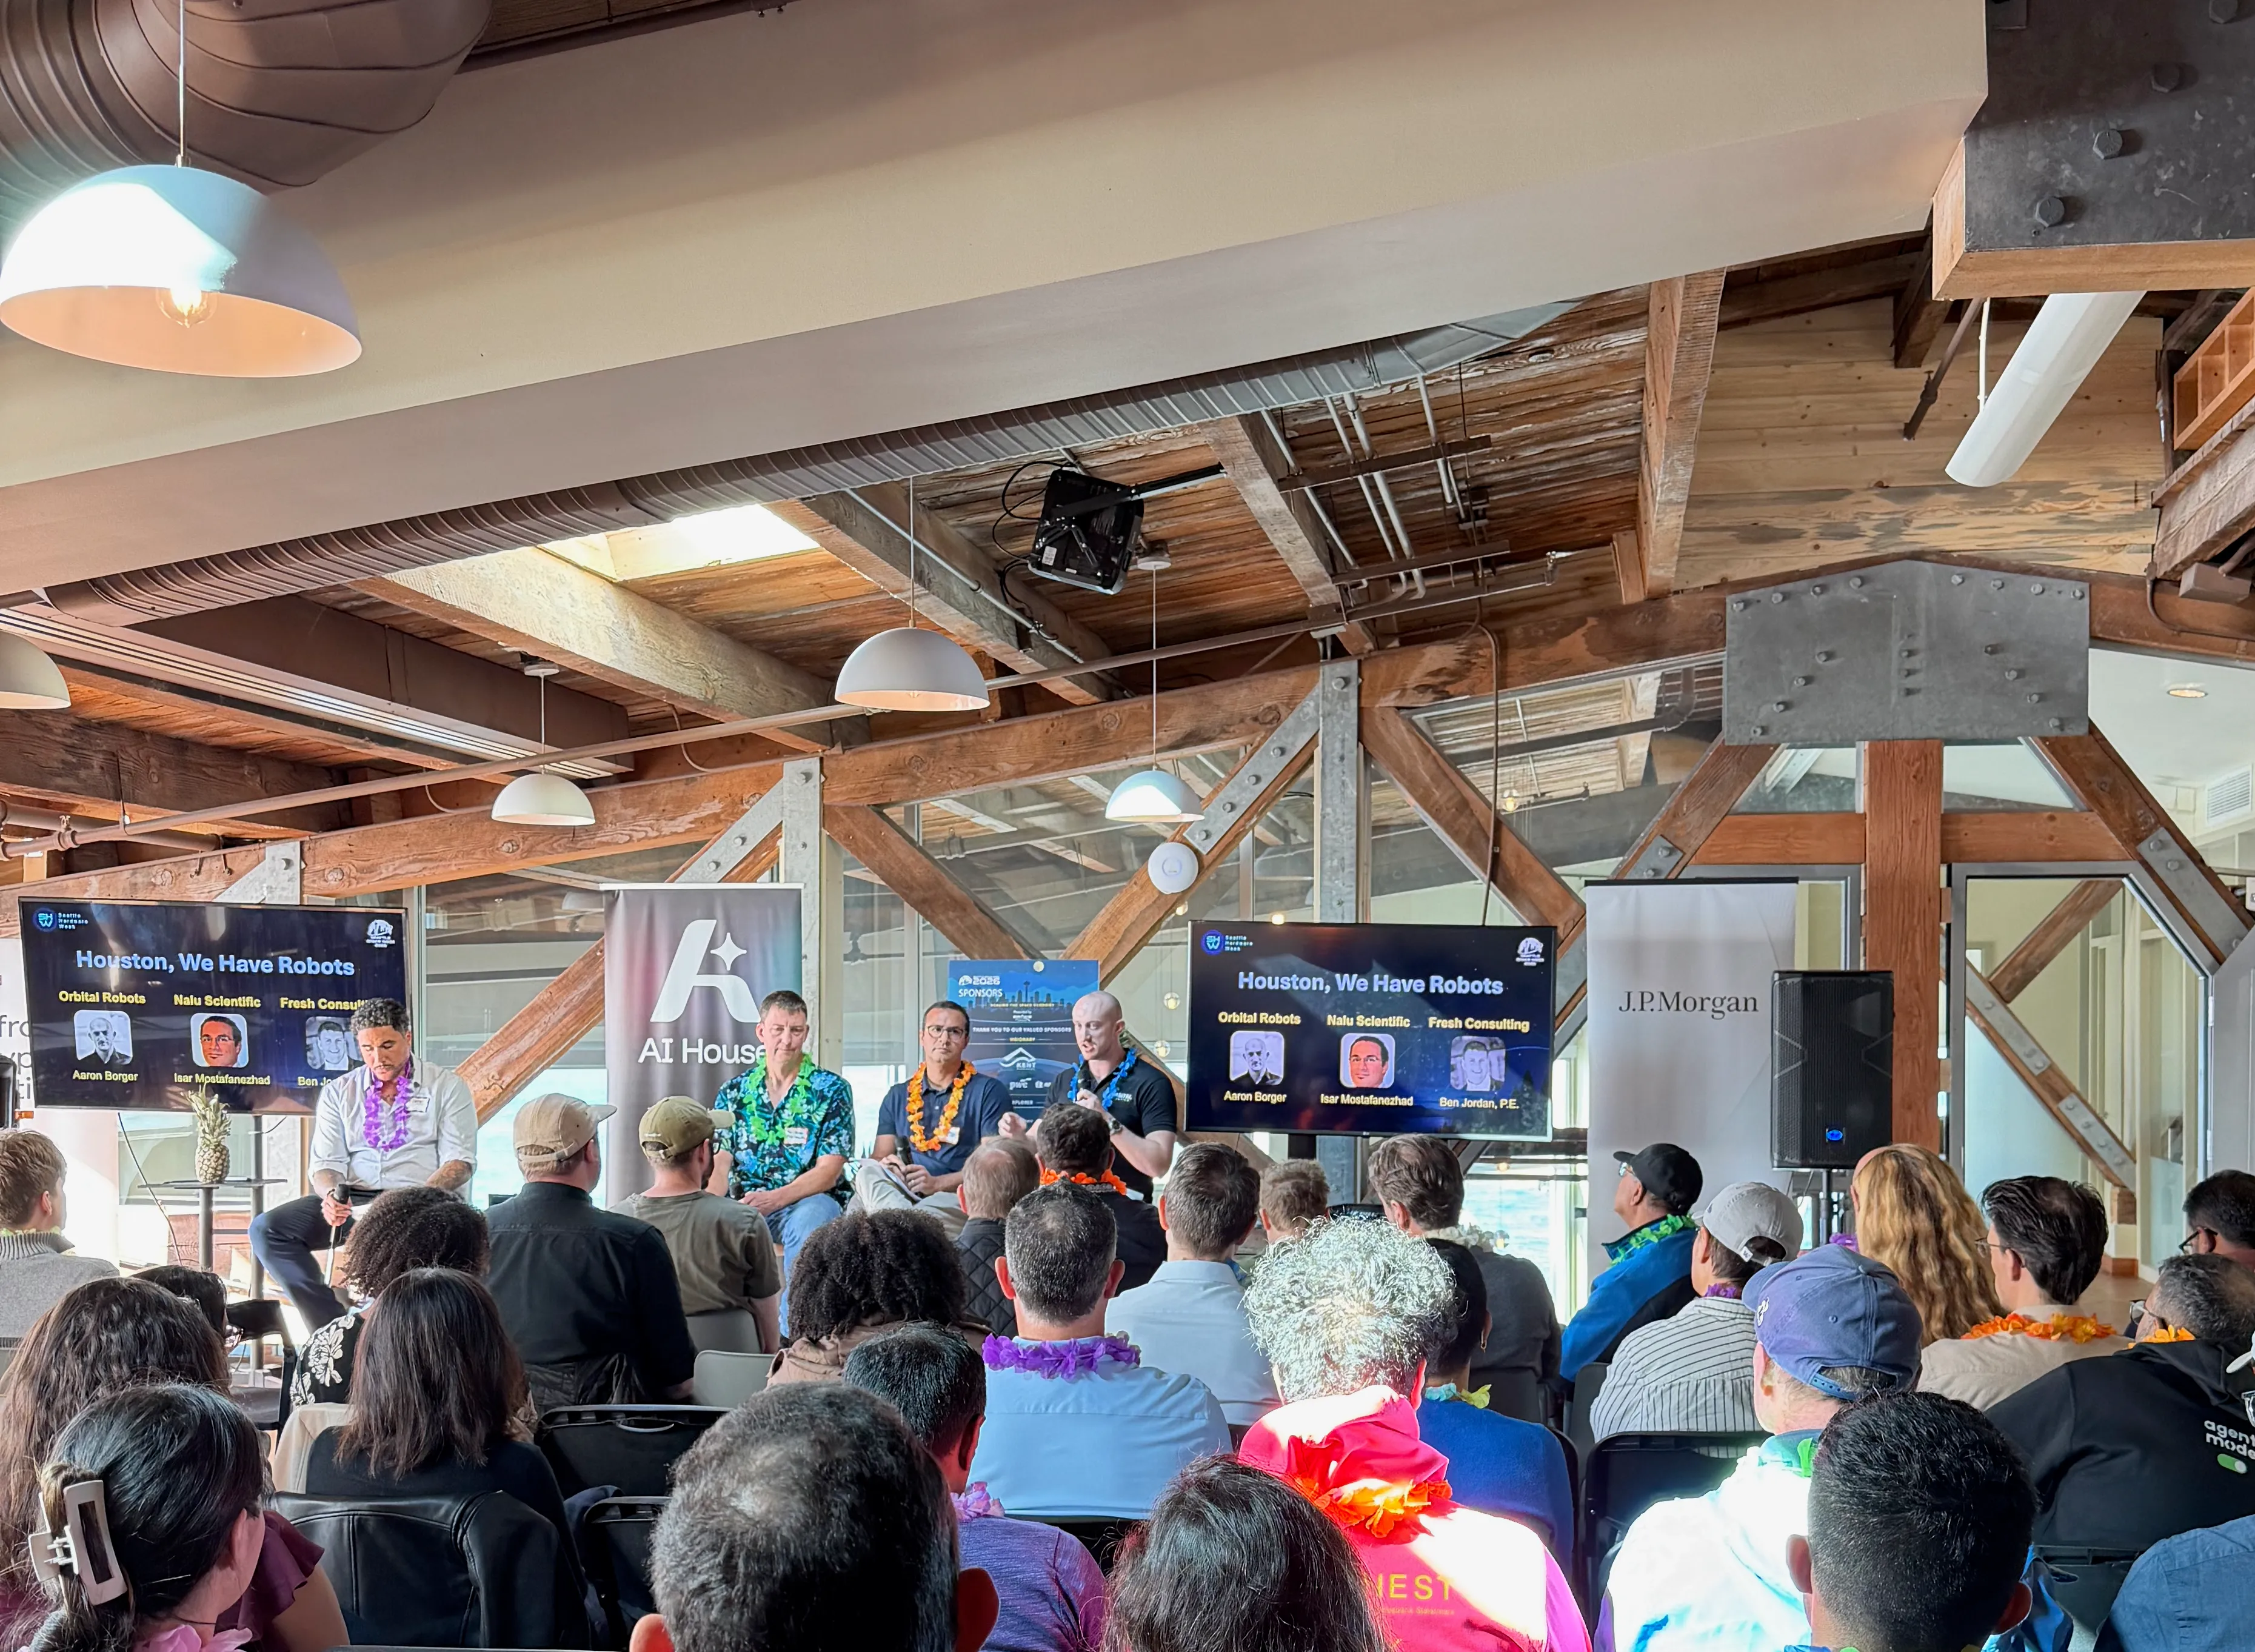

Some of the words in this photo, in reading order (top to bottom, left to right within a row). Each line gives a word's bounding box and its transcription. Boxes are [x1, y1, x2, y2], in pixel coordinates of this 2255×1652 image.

[76, 950, 175, 974] Houston,
[178, 953, 214, 971] We
[219, 954, 274, 973] Have
[278, 956, 355, 975] Robots
[1238, 971, 1331, 994] Houston,
[1335, 973, 1369, 992] We
[1373, 974, 1425, 993] Have
[1429, 975, 1503, 995] Robots
[58, 991, 99, 1003] Orbital
[102, 992, 146, 1005] Robots
[958, 988, 1003, 998] SPONSORS
[173, 994, 202, 1006] Nalu
[204, 995, 261, 1008] Scientific
[279, 997, 315, 1009] Fresh
[318, 998, 365, 1011] Consul
[1618, 990, 1759, 1020] J.P.Morgan
[1217, 1011, 1257, 1023] Orbital
[1259, 1012, 1301, 1025] Robots
[1326, 1014, 1354, 1027] Nalu
[1355, 1015, 1411, 1028] Scientific
[1428, 1016, 1463, 1029] Fresh
[1465, 1017, 1531, 1033] Consulting
[638, 1038, 673, 1063] AI
[72, 1069, 102, 1081] Aaron
[104, 1071, 139, 1083] Borger
[298, 1076, 318, 1086] Ben
[1223, 1090, 1252, 1102] Aaron
[1254, 1091, 1287, 1104] Borger
[1320, 1093, 1339, 1104] Isar
[1340, 1094, 1414, 1106] Mostafanezhad
[1439, 1097, 1460, 1108] Ben
[1461, 1098, 1498, 1111] Jordan,
[1500, 1099, 1520, 1110] P.E.
[2204, 1420, 2255, 1447] agent
[2206, 1433, 2255, 1460] mode
